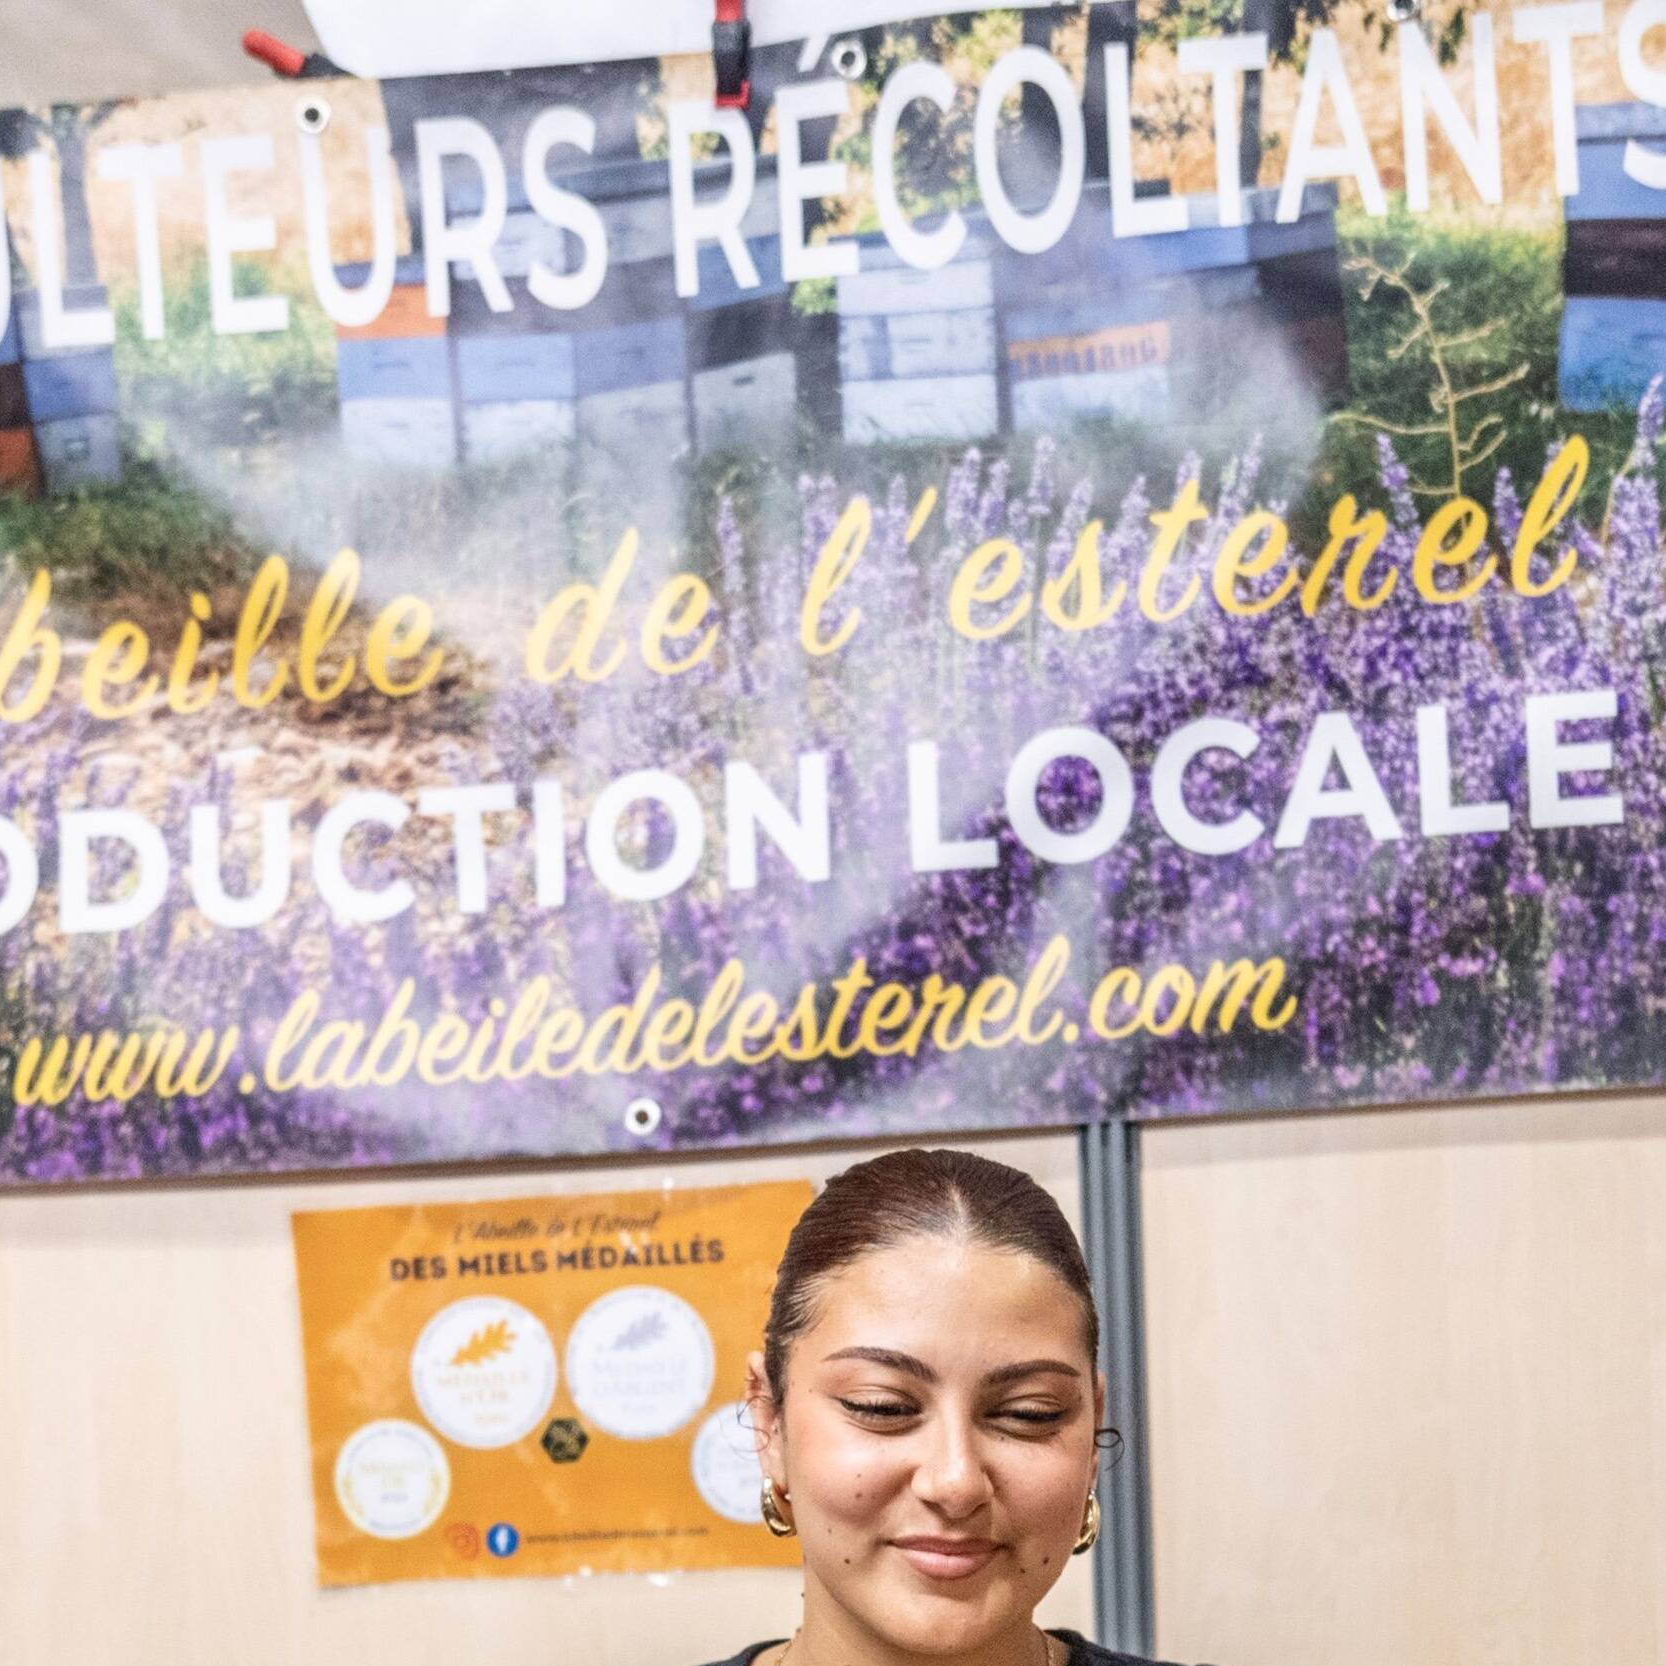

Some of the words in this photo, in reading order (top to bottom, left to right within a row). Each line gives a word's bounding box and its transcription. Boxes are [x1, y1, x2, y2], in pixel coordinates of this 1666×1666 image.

[525, 527, 721, 685] de
[799, 434, 1593, 658] l'esterel
[906, 689, 1625, 872] LOCALE
[390, 1256, 447, 1281] DES
[458, 1249, 547, 1277] MIELS
[556, 1233, 725, 1271] MÉDAILLÉS
